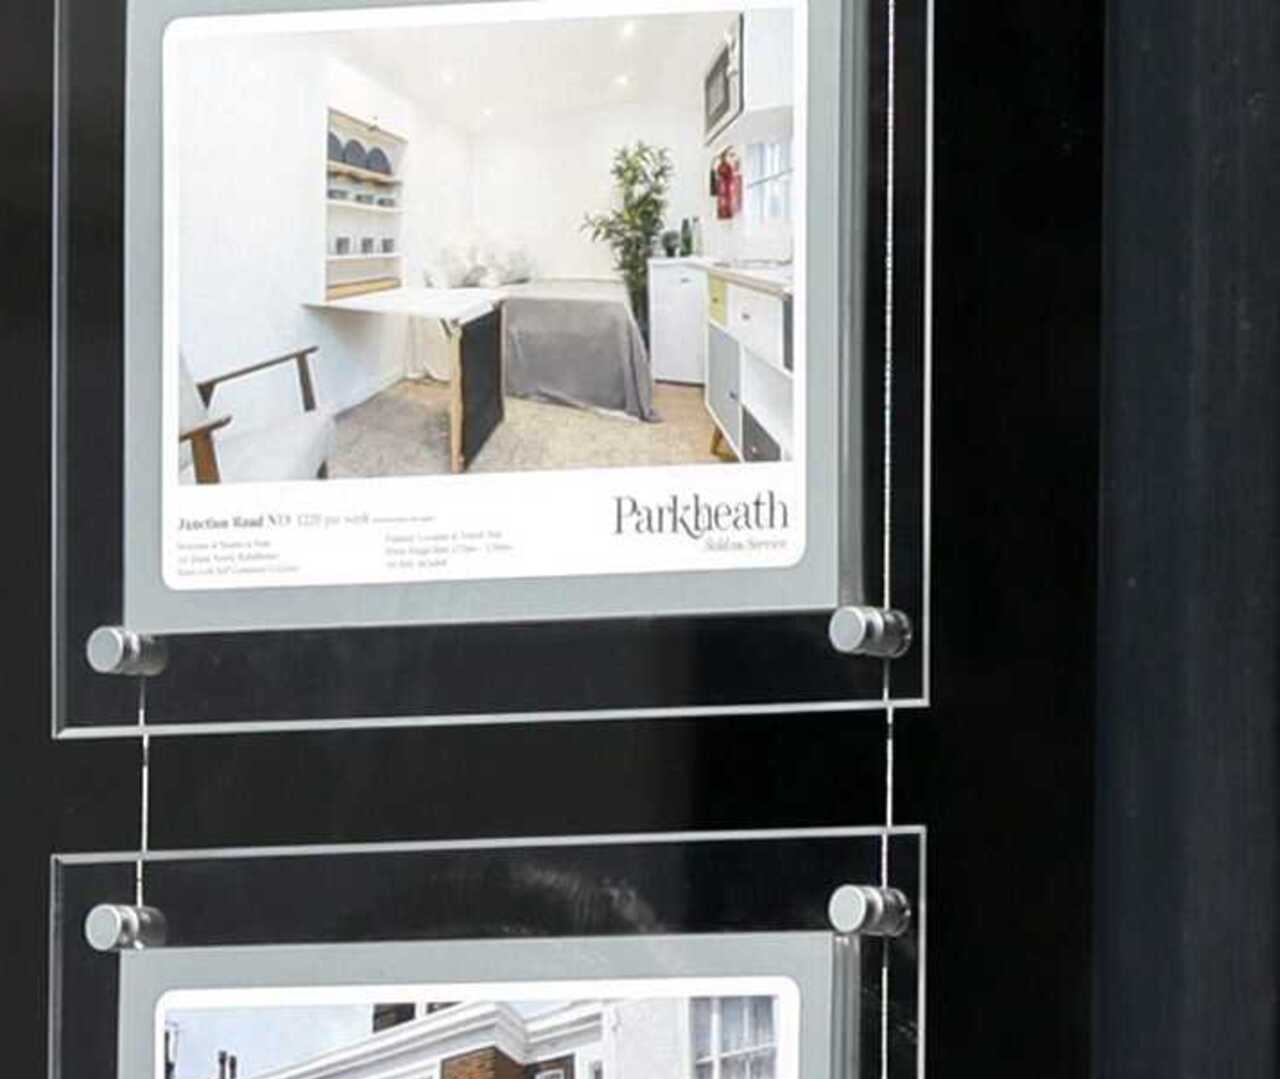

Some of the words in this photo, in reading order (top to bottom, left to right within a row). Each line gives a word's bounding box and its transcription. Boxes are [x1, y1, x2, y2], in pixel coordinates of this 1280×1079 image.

[177, 517, 229, 531] Junction
[232, 514, 264, 529] Road
[613, 489, 790, 541] Parkheath
